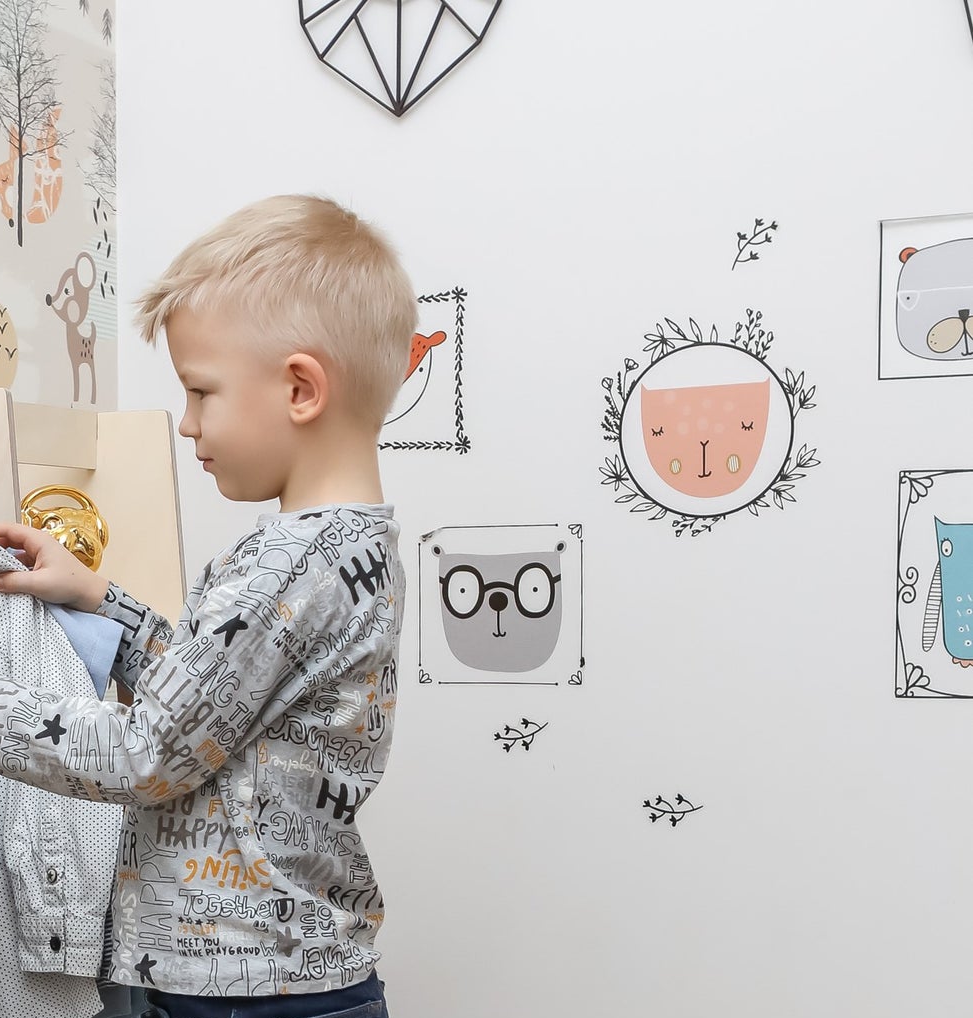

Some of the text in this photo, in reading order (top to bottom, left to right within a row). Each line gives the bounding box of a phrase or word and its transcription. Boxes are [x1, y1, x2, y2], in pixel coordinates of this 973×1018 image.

[229, 702, 254, 732] TH
[156, 814, 231, 854] HAPPY
[138, 833, 178, 952] HAPPY
[300, 900, 318, 939] FUN
[177, 937, 220, 949] MEET YOU
